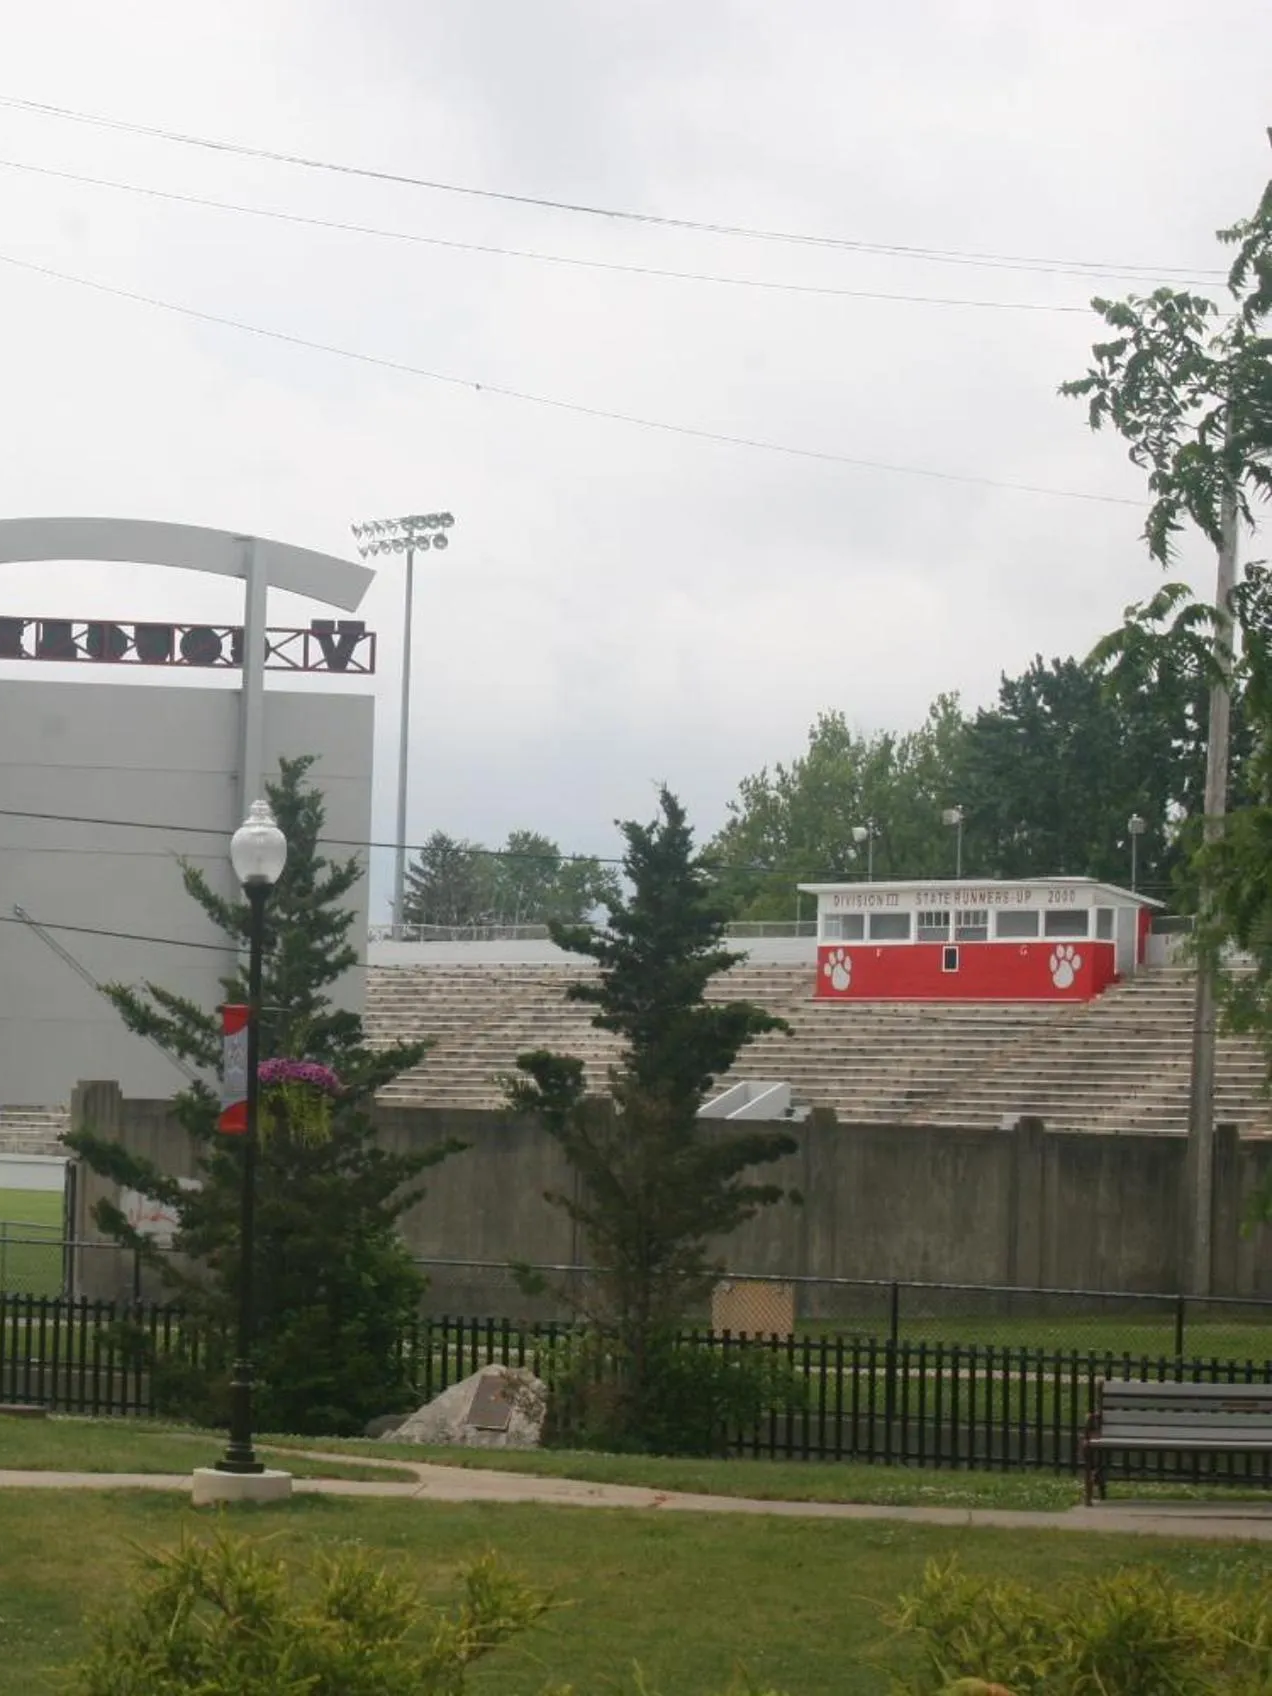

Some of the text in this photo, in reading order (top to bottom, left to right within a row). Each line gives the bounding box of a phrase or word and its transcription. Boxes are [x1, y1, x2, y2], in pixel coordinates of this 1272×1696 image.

[833, 893, 883, 908] DIVISION
[915, 891, 951, 906] STATE
[1047, 889, 1077, 905] 2000
